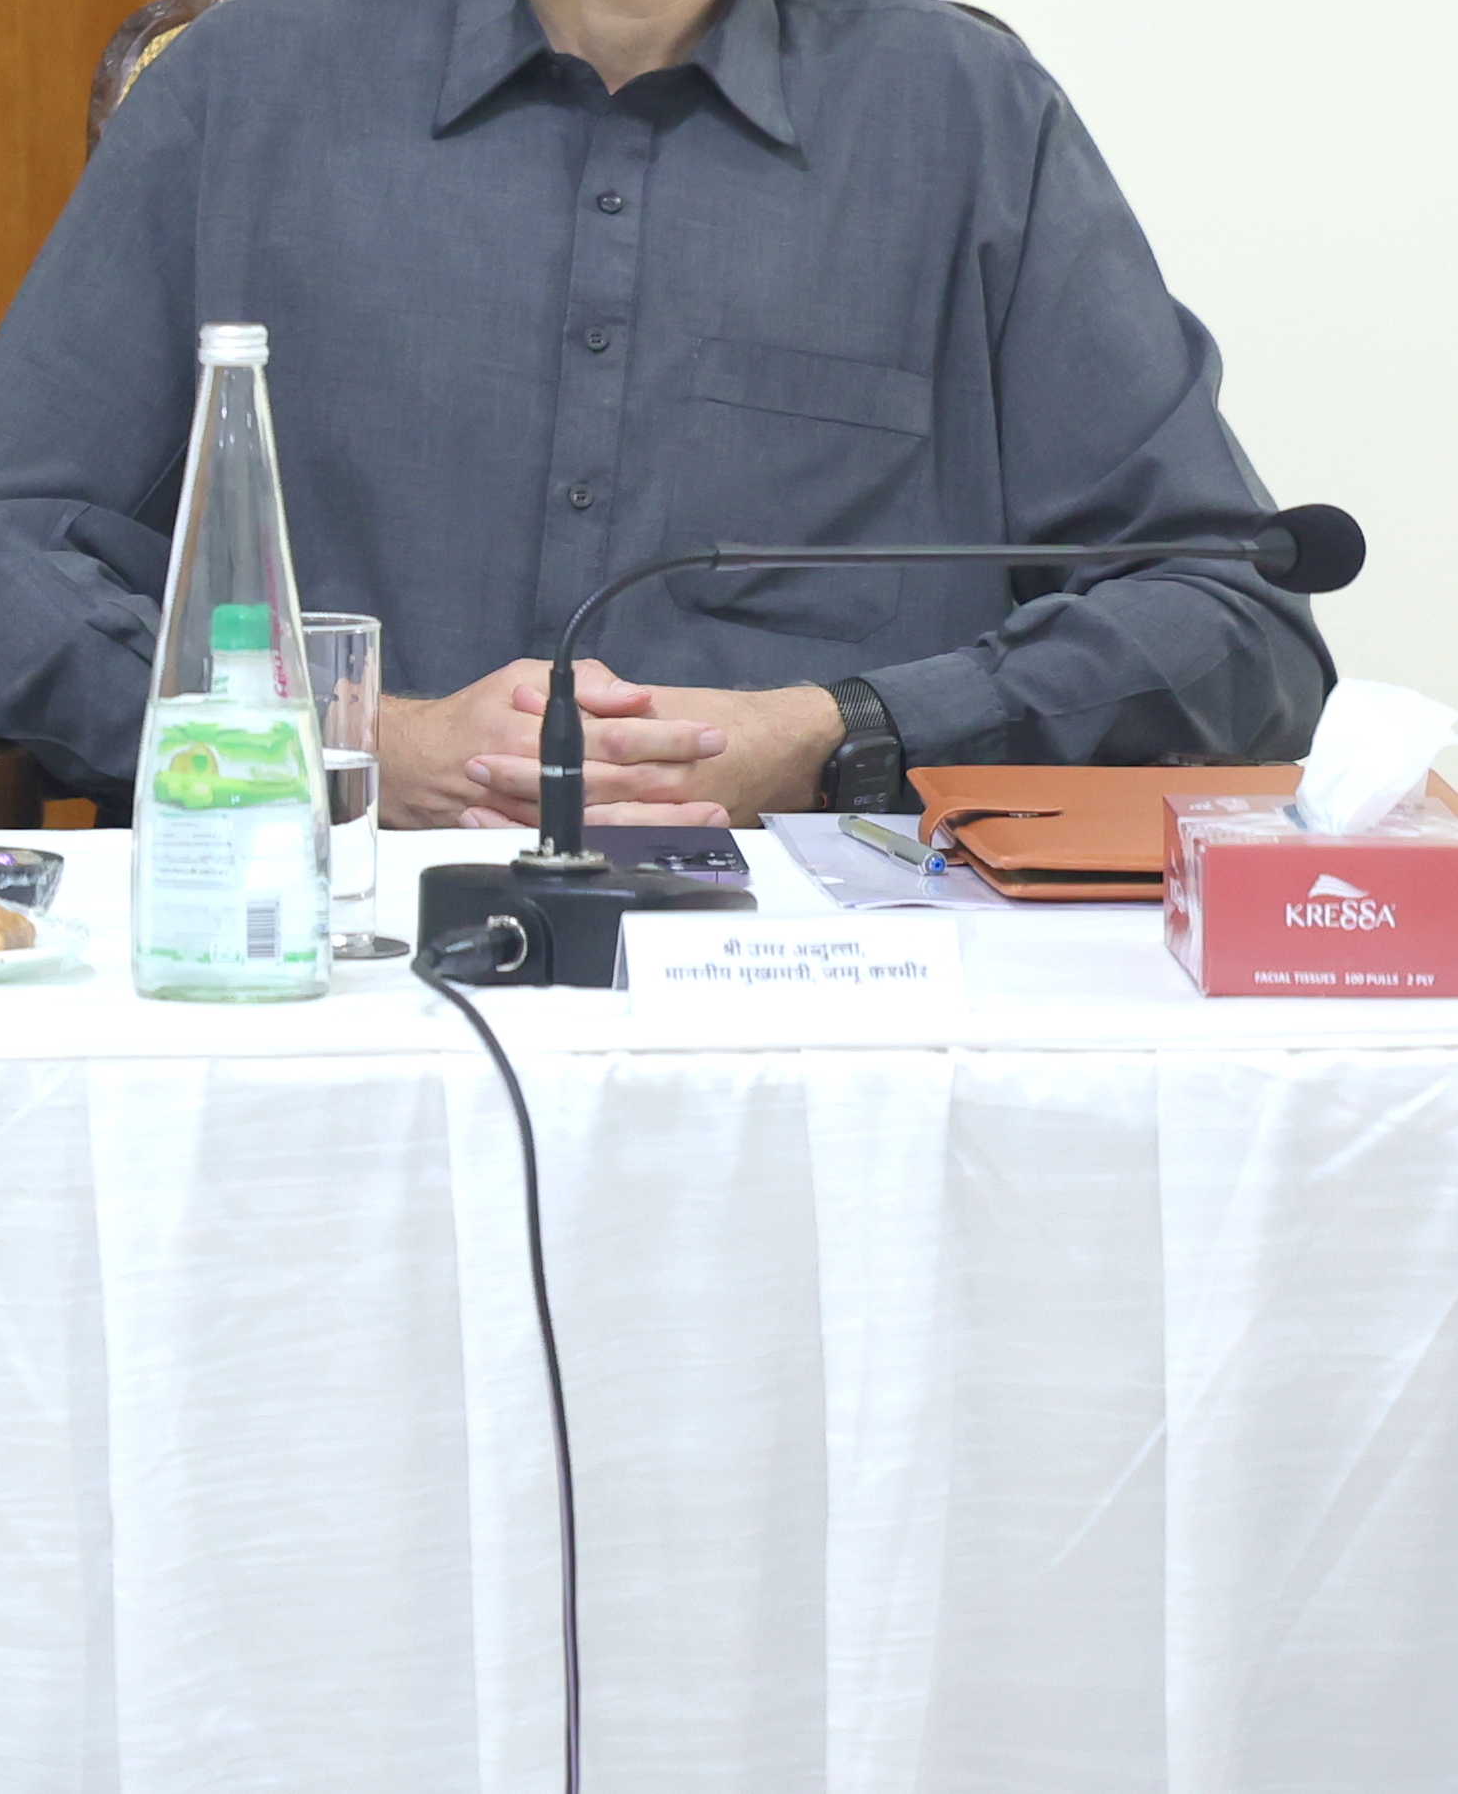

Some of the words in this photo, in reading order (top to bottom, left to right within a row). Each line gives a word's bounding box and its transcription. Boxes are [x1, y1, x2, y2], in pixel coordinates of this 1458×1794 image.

[1285, 899, 1396, 931] KRESSA
[723, 937, 742, 958] श्री
[747, 941, 786, 958] उमर
[664, 961, 732, 981] माननीय
[1254, 970, 1291, 985] FACIAL
[1293, 970, 1337, 985] TISSUES
[1344, 971, 1365, 986] 100
[1365, 972, 1400, 986] PULLS
